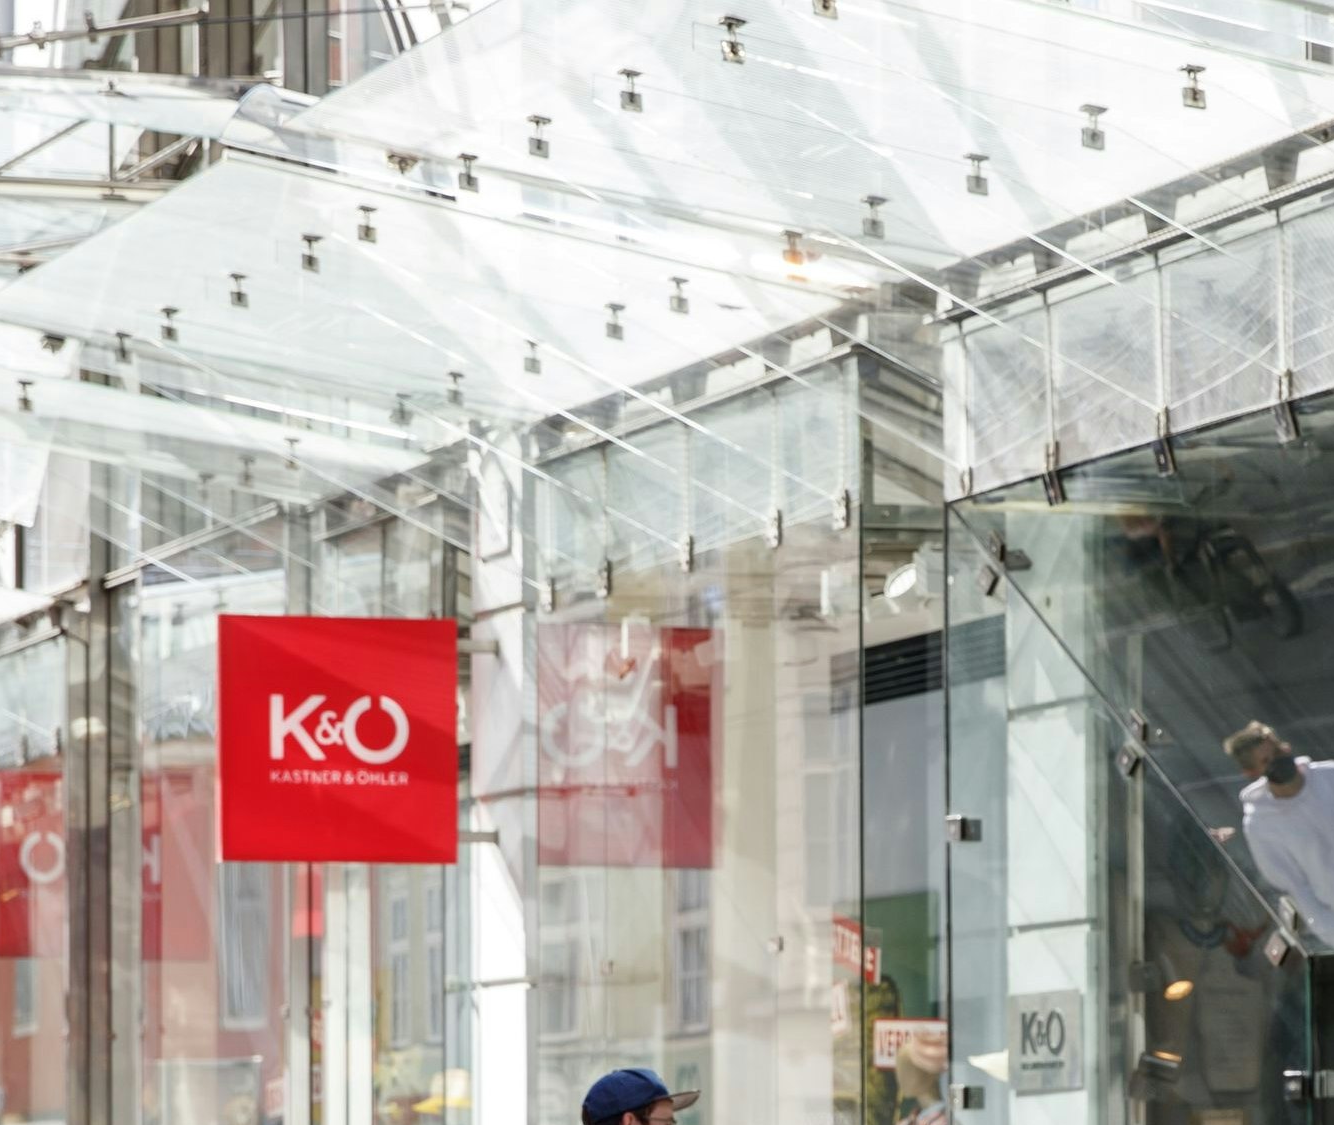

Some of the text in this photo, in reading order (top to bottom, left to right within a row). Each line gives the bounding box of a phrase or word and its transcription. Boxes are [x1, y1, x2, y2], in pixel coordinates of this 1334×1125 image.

[269, 768, 408, 785] KASTNER & ÖHLER
